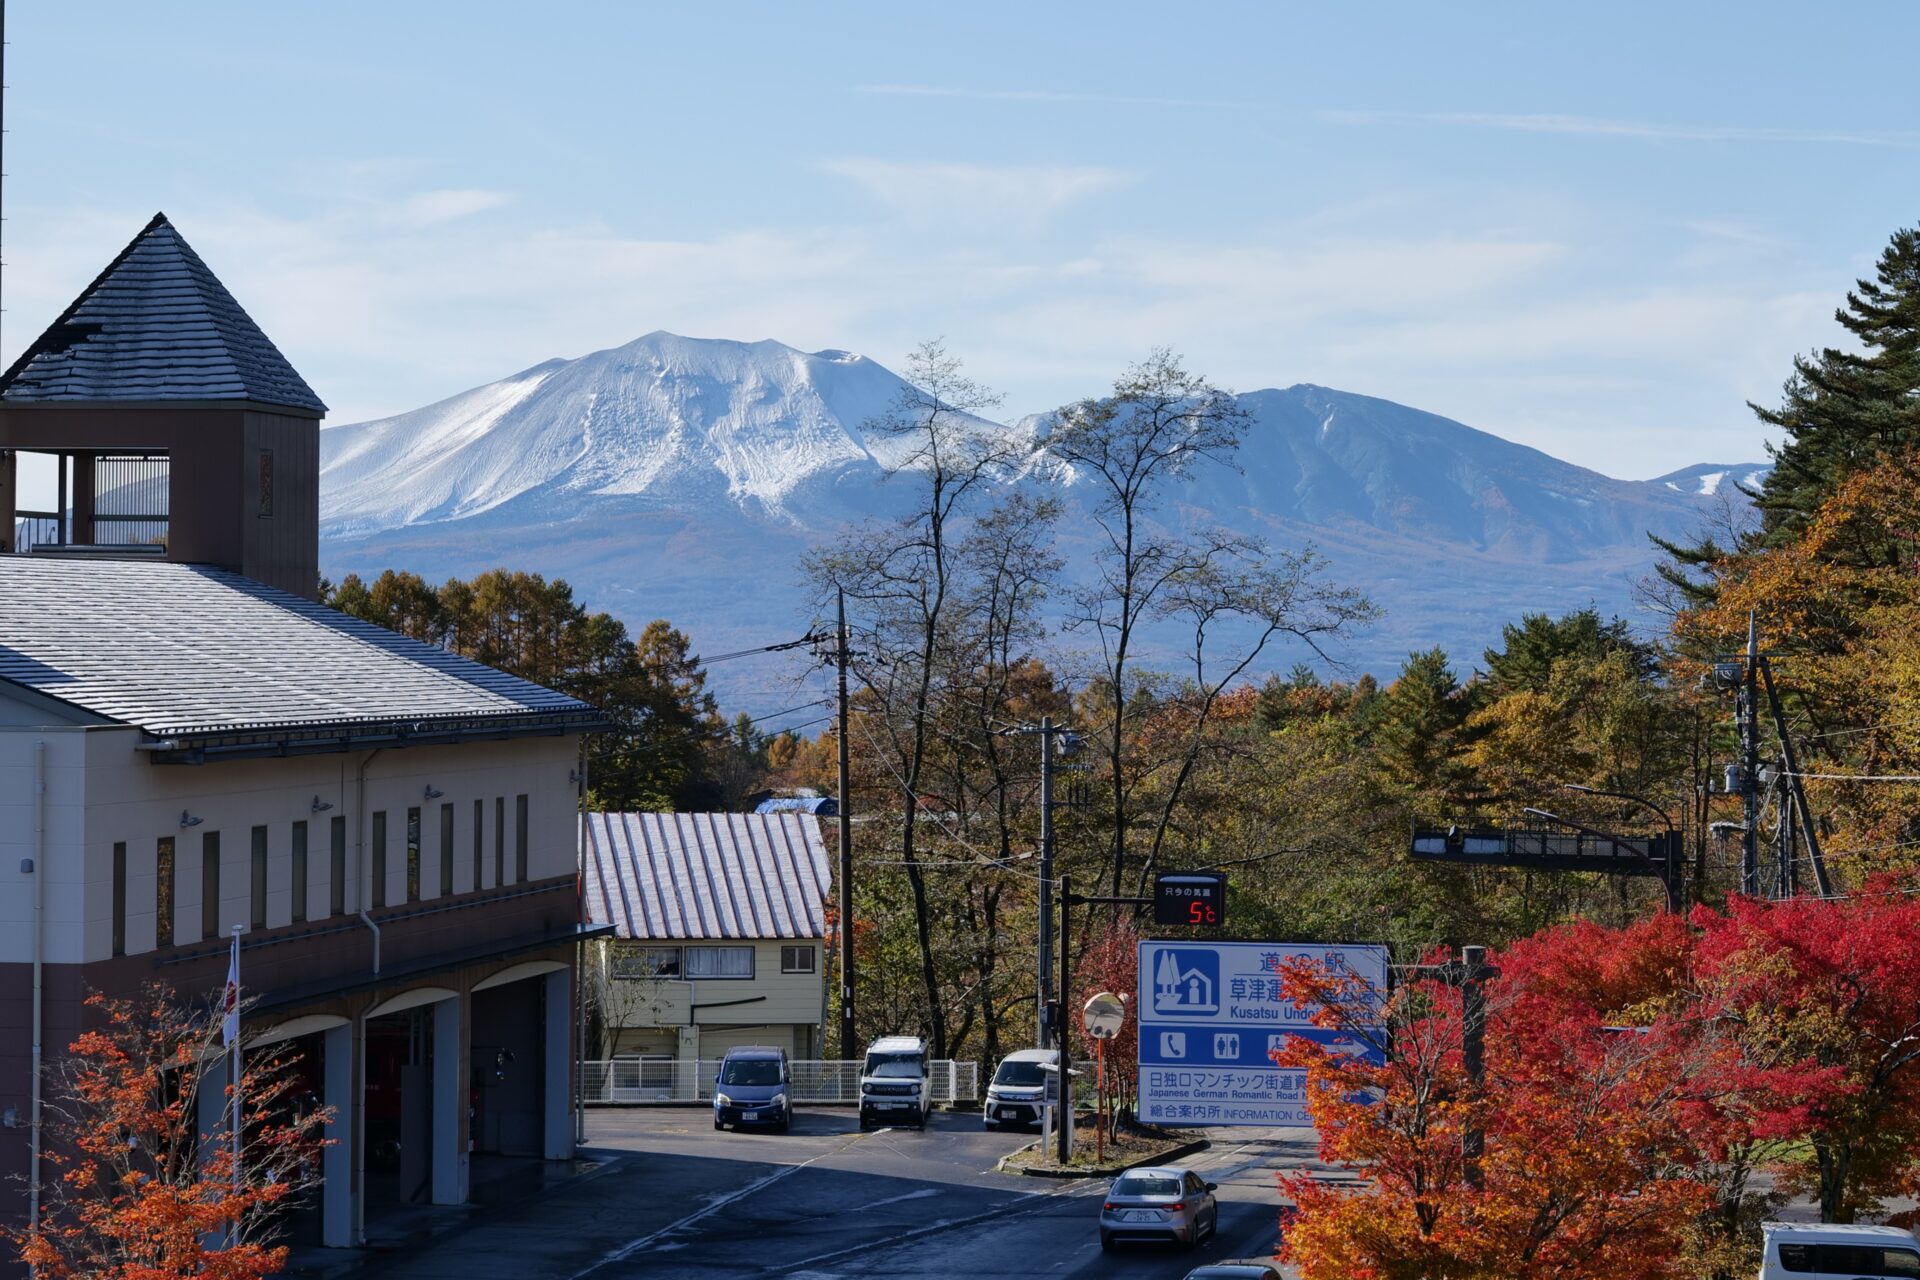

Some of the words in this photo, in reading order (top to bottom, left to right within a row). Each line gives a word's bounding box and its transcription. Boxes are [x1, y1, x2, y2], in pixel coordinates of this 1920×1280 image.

[1230, 1005, 1278, 1020] Kusatsu
[1148, 1089, 1190, 1098] Japanese
[1193, 1089, 1228, 1099] German
[1231, 1089, 1273, 1100] Romantic
[1276, 1091, 1299, 1100] Road
[1150, 1104, 1221, 1119] 総合案内所
[1224, 1109, 1293, 1121] INFORMATION
